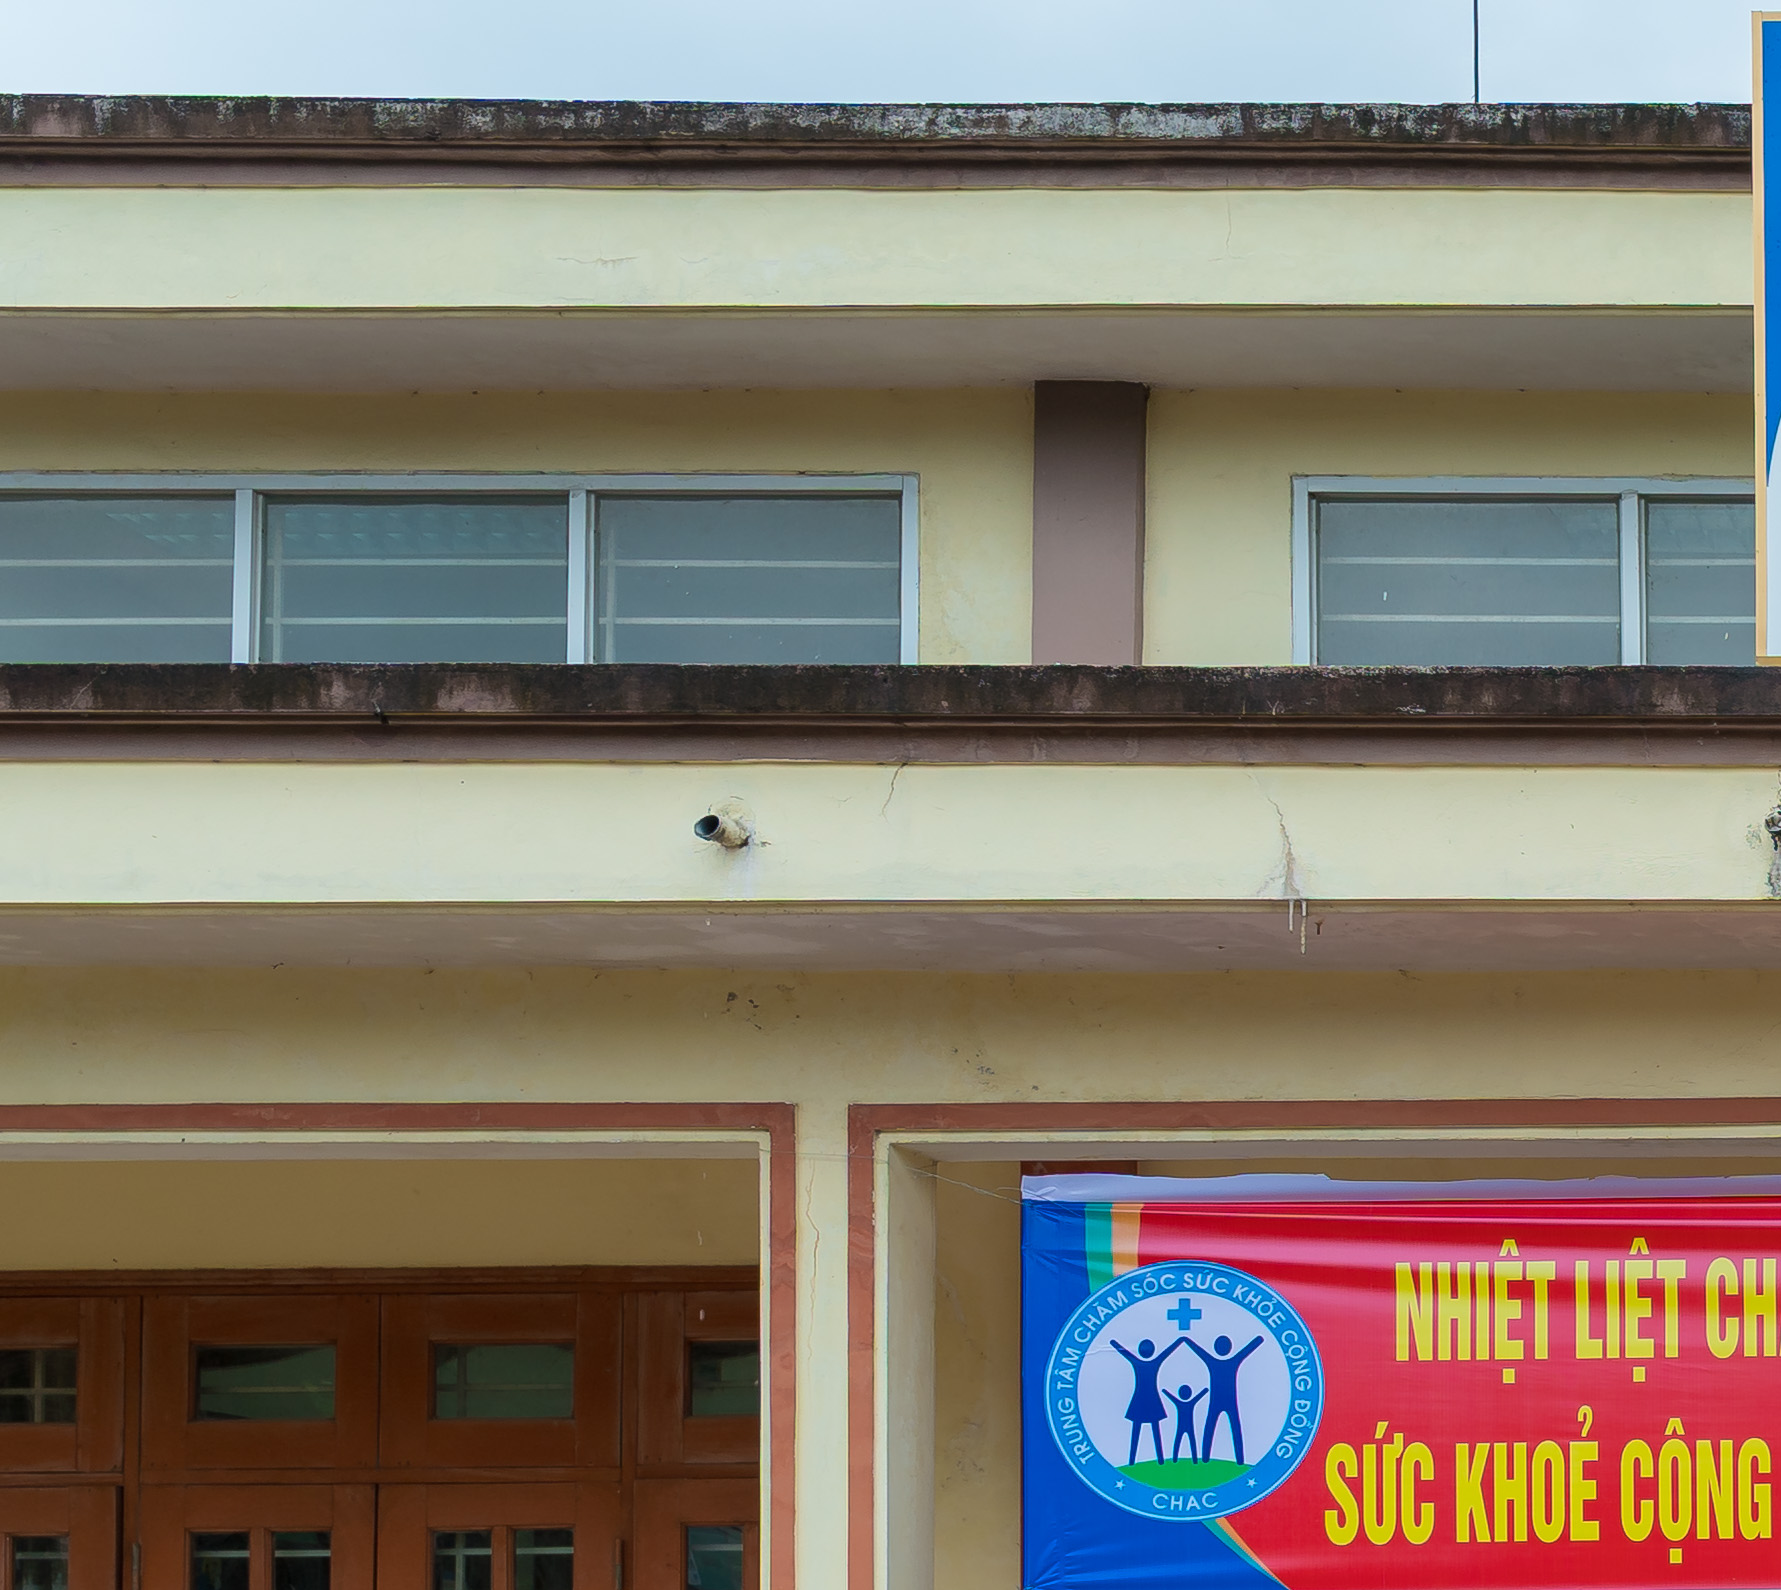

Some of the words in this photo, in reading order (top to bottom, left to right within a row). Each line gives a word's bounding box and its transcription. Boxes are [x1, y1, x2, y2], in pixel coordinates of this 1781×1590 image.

[1131, 1269, 1177, 1298] SÓC
[1183, 1269, 1230, 1293] SỨC
[1232, 1283, 1285, 1329] KHỎE
[1073, 1290, 1128, 1343] CHĂM
[1395, 1239, 1557, 1385] NHIỆT
[1574, 1238, 1687, 1383] LIỆT
[1054, 1347, 1082, 1391] TÂM
[1281, 1329, 1312, 1393] CỘNG
[1058, 1397, 1096, 1464] TRUNG
[1275, 1399, 1314, 1460] ĐỒNG
[1152, 1492, 1218, 1511] CHAC
[1325, 1421, 1434, 1546] SỨC
[1621, 1418, 1772, 1563] CỘNG
